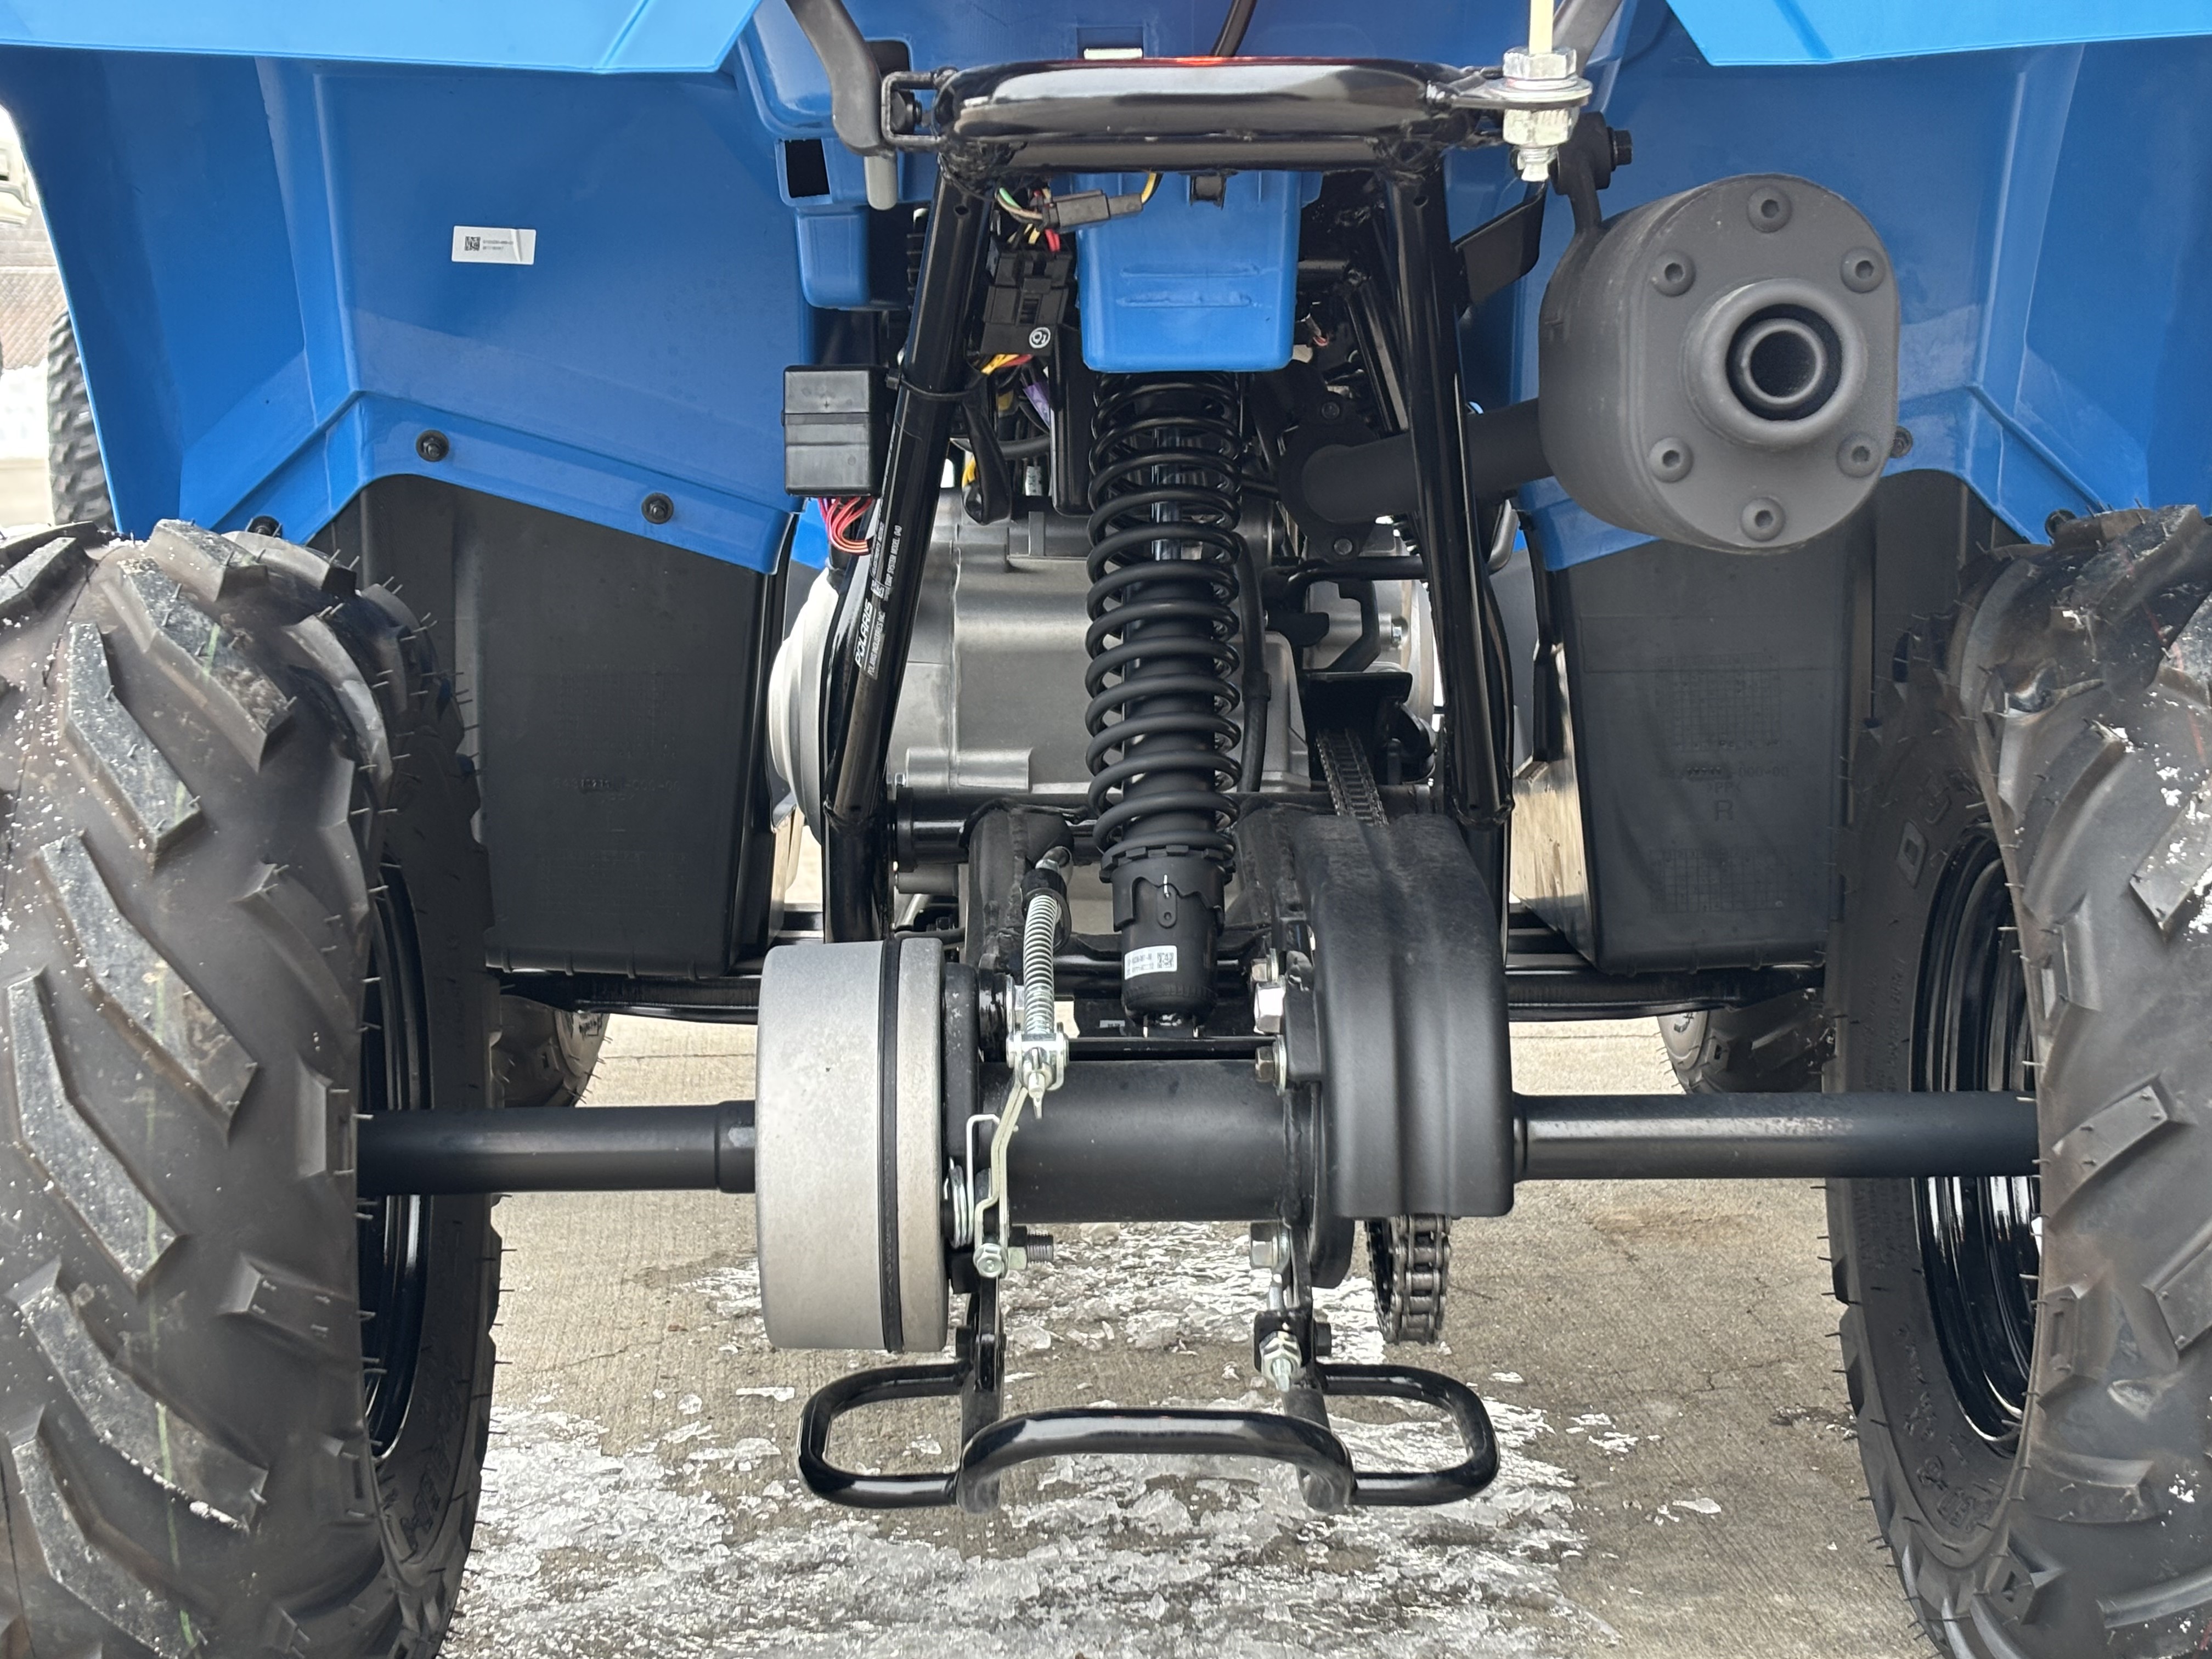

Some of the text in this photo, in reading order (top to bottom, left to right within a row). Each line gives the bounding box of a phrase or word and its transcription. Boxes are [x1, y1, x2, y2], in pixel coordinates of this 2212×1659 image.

[854, 597, 873, 668] POLARIS
[872, 620, 884, 653] INDUSTRIES
[868, 652, 878, 676] POLARIS
[1713, 799, 1734, 821] R
